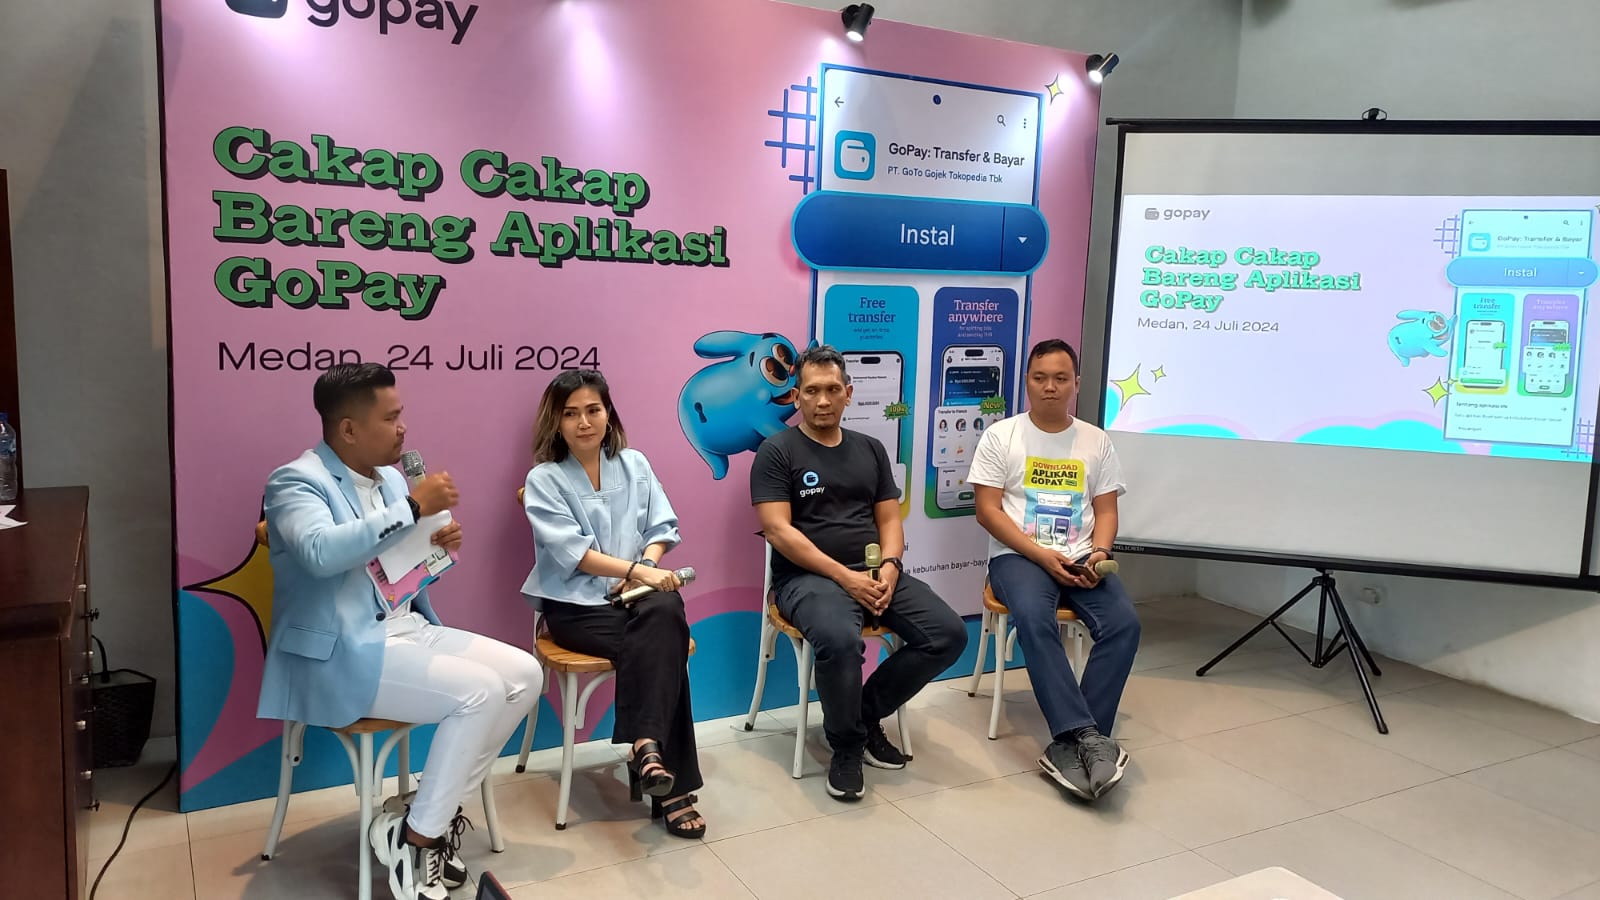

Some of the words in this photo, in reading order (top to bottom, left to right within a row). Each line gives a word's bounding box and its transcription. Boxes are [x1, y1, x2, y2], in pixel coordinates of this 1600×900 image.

[888, 143, 931, 161] GoPay:
[933, 147, 981, 163] Transfer
[982, 151, 991, 163] &
[993, 152, 1025, 168] Bayar
[213, 126, 443, 201] Cakap
[460, 149, 651, 213] Cakap
[887, 166, 900, 175] PT.
[902, 167, 923, 177] GoTo
[924, 169, 947, 181] Gojek
[948, 171, 988, 182] Tokopedia
[988, 174, 1003, 183] Tbk
[1163, 208, 1211, 221] gopay
[212, 191, 475, 263] Bareng
[490, 210, 730, 268] Aplikasi
[900, 223, 955, 247] Instal
[1144, 246, 1227, 268] Cakap
[1234, 247, 1321, 270] Cakap
[1504, 267, 1537, 278] Instal
[1142, 268, 1239, 291] Bareng
[1244, 270, 1362, 292] Aplikasi
[214, 255, 446, 321] GoPay
[859, 297, 886, 309] Free
[953, 299, 1000, 311] Transfer
[1140, 290, 1224, 313] GoPay
[848, 311, 897, 323] transfer
[948, 311, 1004, 325] anywhere
[1137, 317, 1189, 331] Medan,
[1192, 320, 1210, 330] 24
[1214, 320, 1239, 331] Juli
[1242, 321, 1280, 332] 2024
[387, 344, 434, 371] 24
[445, 343, 503, 371] Juli
[514, 345, 600, 371] 2024
[1032, 461, 1078, 471] DOWNLOAD
[1032, 468, 1078, 479] APLIKASI
[1031, 476, 1064, 486] GOPAY
[799, 486, 826, 498] gopay
[912, 562, 950, 574] kebutuhan
